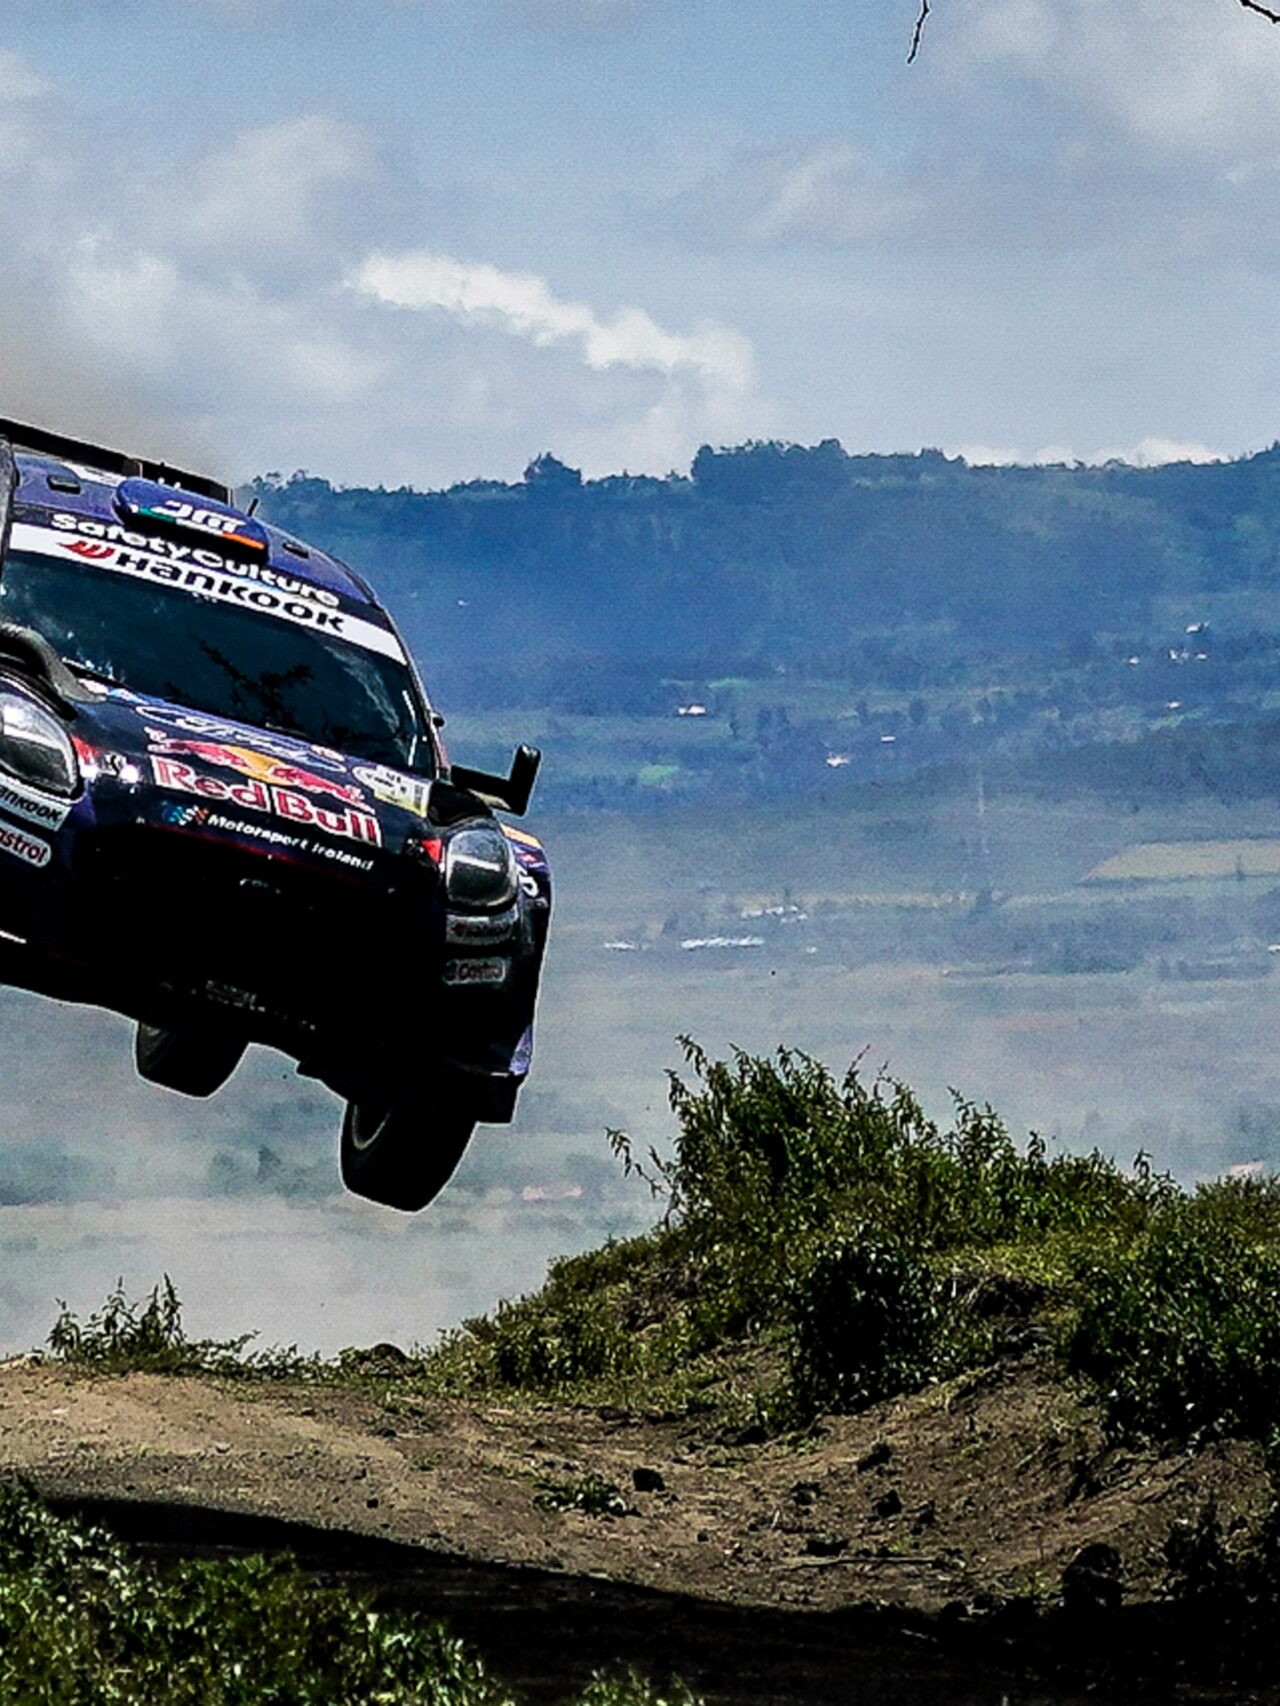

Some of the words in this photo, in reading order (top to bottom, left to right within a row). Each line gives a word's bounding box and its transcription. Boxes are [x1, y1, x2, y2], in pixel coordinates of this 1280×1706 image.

[51, 513, 340, 608] SafetyCulture
[150, 754, 269, 812] Red
[272, 786, 382, 847] Bull
[208, 814, 308, 850] Motorsport
